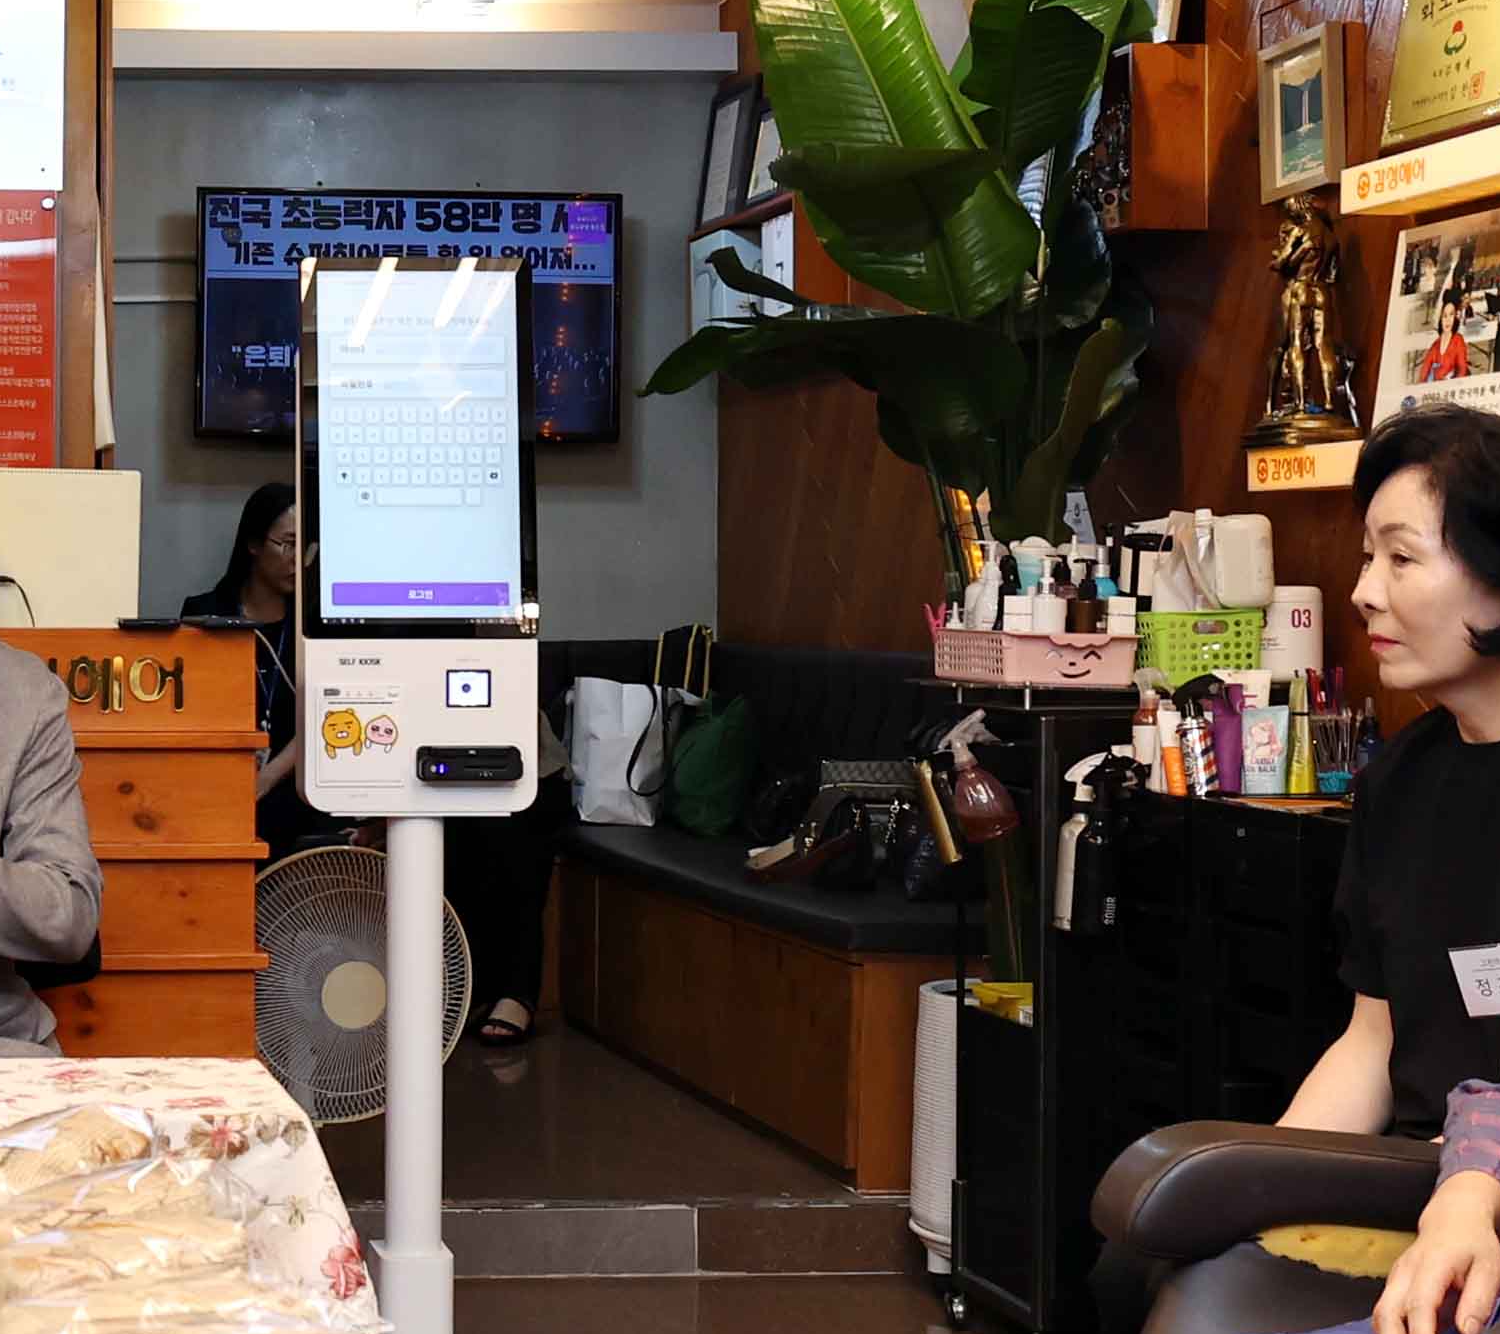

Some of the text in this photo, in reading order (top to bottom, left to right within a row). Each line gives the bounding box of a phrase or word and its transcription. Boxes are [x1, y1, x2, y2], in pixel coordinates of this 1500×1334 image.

[208, 197, 273, 230] 전국
[281, 198, 406, 231] 초능력자
[415, 201, 503, 234] 58만
[511, 203, 543, 234] 명
[1291, 608, 1312, 629] 03
